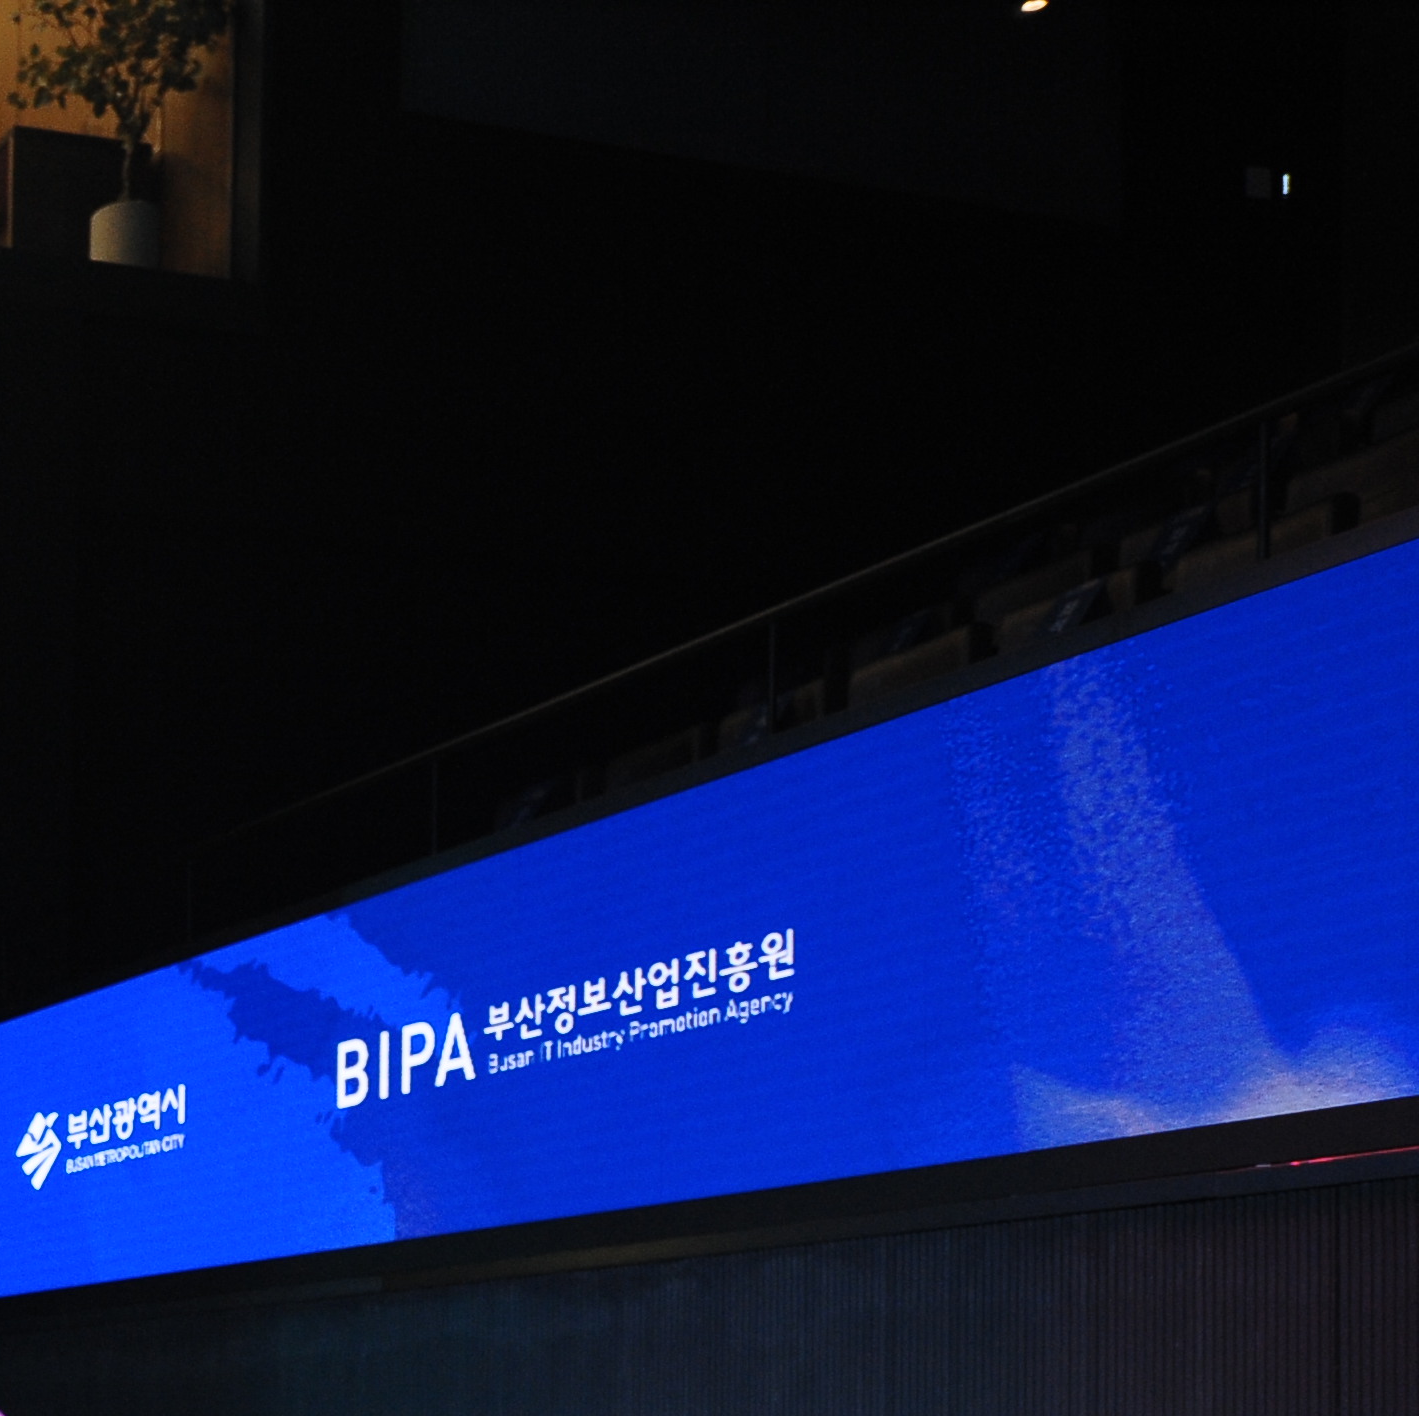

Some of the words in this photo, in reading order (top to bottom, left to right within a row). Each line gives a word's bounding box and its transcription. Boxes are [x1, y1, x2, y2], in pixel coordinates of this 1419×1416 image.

[483, 928, 795, 1041] 부산정보산업진흥원
[336, 1012, 476, 1109] BIPA
[488, 1049, 534, 1075] Busan
[558, 1028, 626, 1059] Industry
[630, 1007, 721, 1042] Promotion
[725, 992, 794, 1024] Agency
[67, 1083, 186, 1149] 부산광역시
[162, 1133, 185, 1152] CITY
